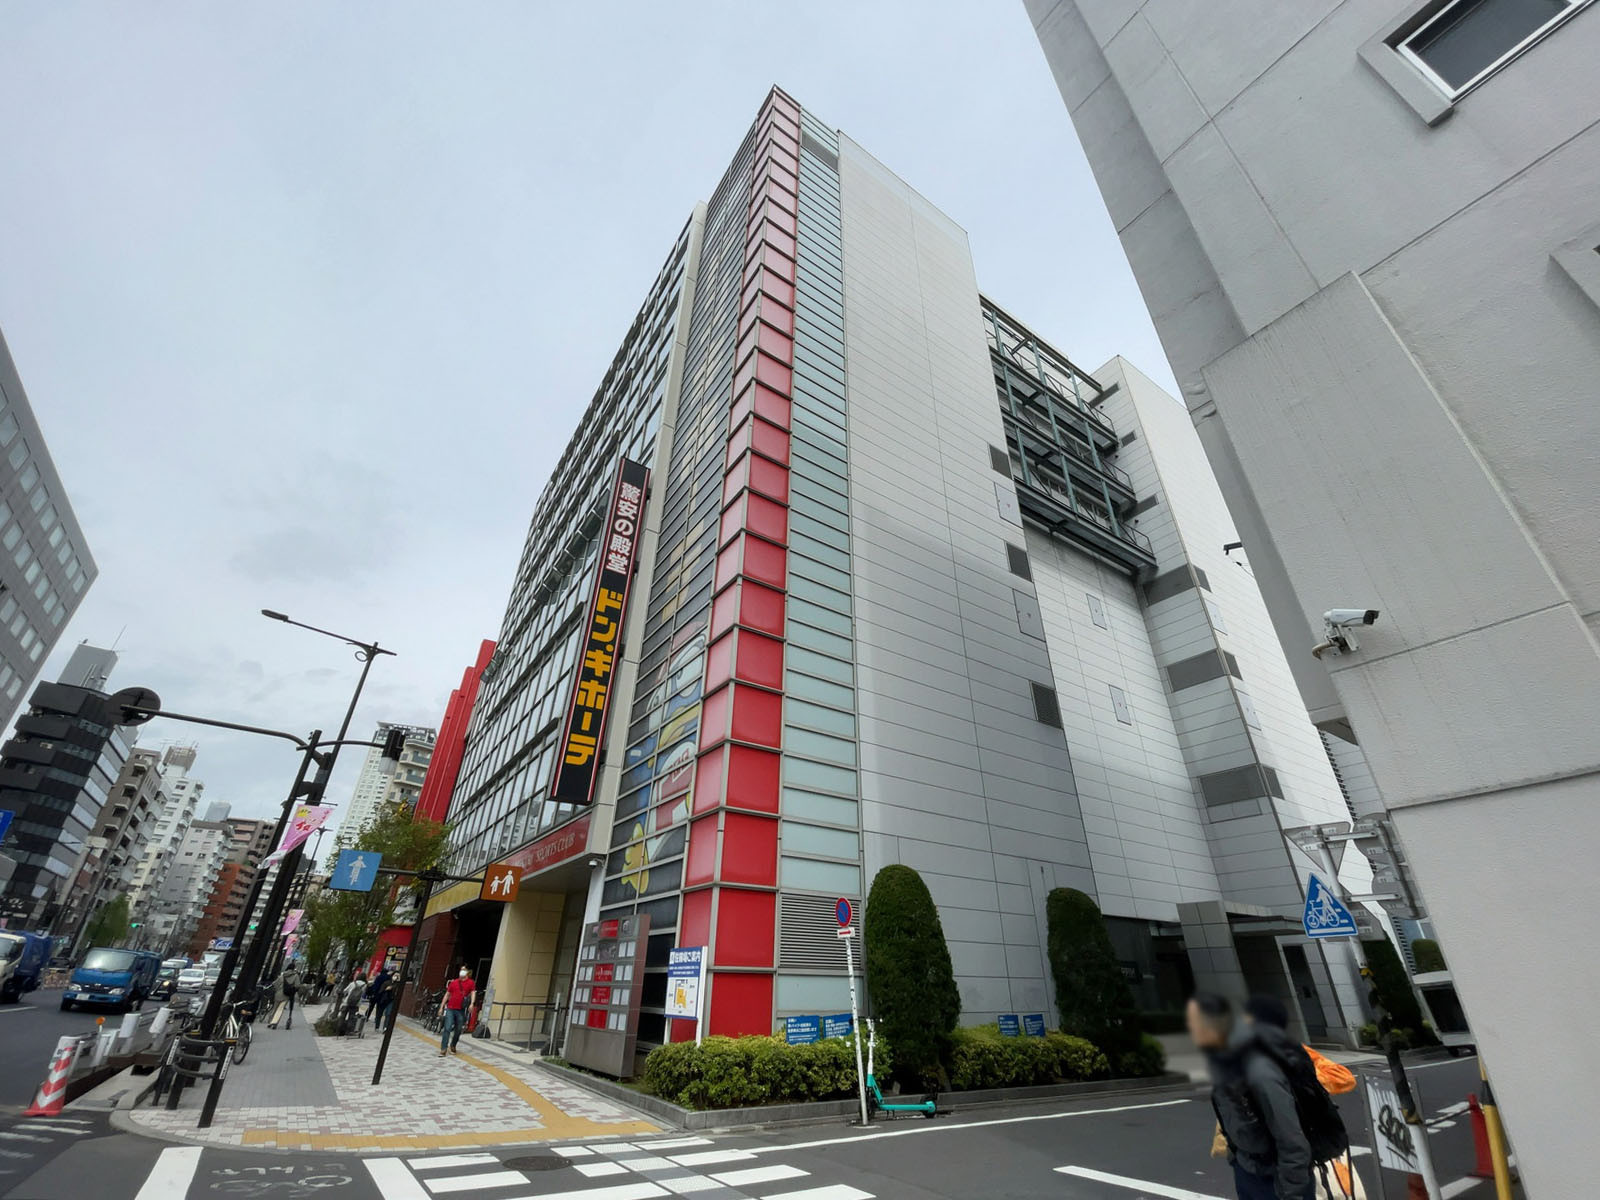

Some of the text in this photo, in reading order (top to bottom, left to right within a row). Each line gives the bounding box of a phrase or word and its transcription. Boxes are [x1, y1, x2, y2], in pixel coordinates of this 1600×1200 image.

[565, 482, 641, 766] 驚安の殿堂 ドン・キホーテ
[536, 841, 557, 862] SPORTS
[557, 833, 576, 852] CLUB
